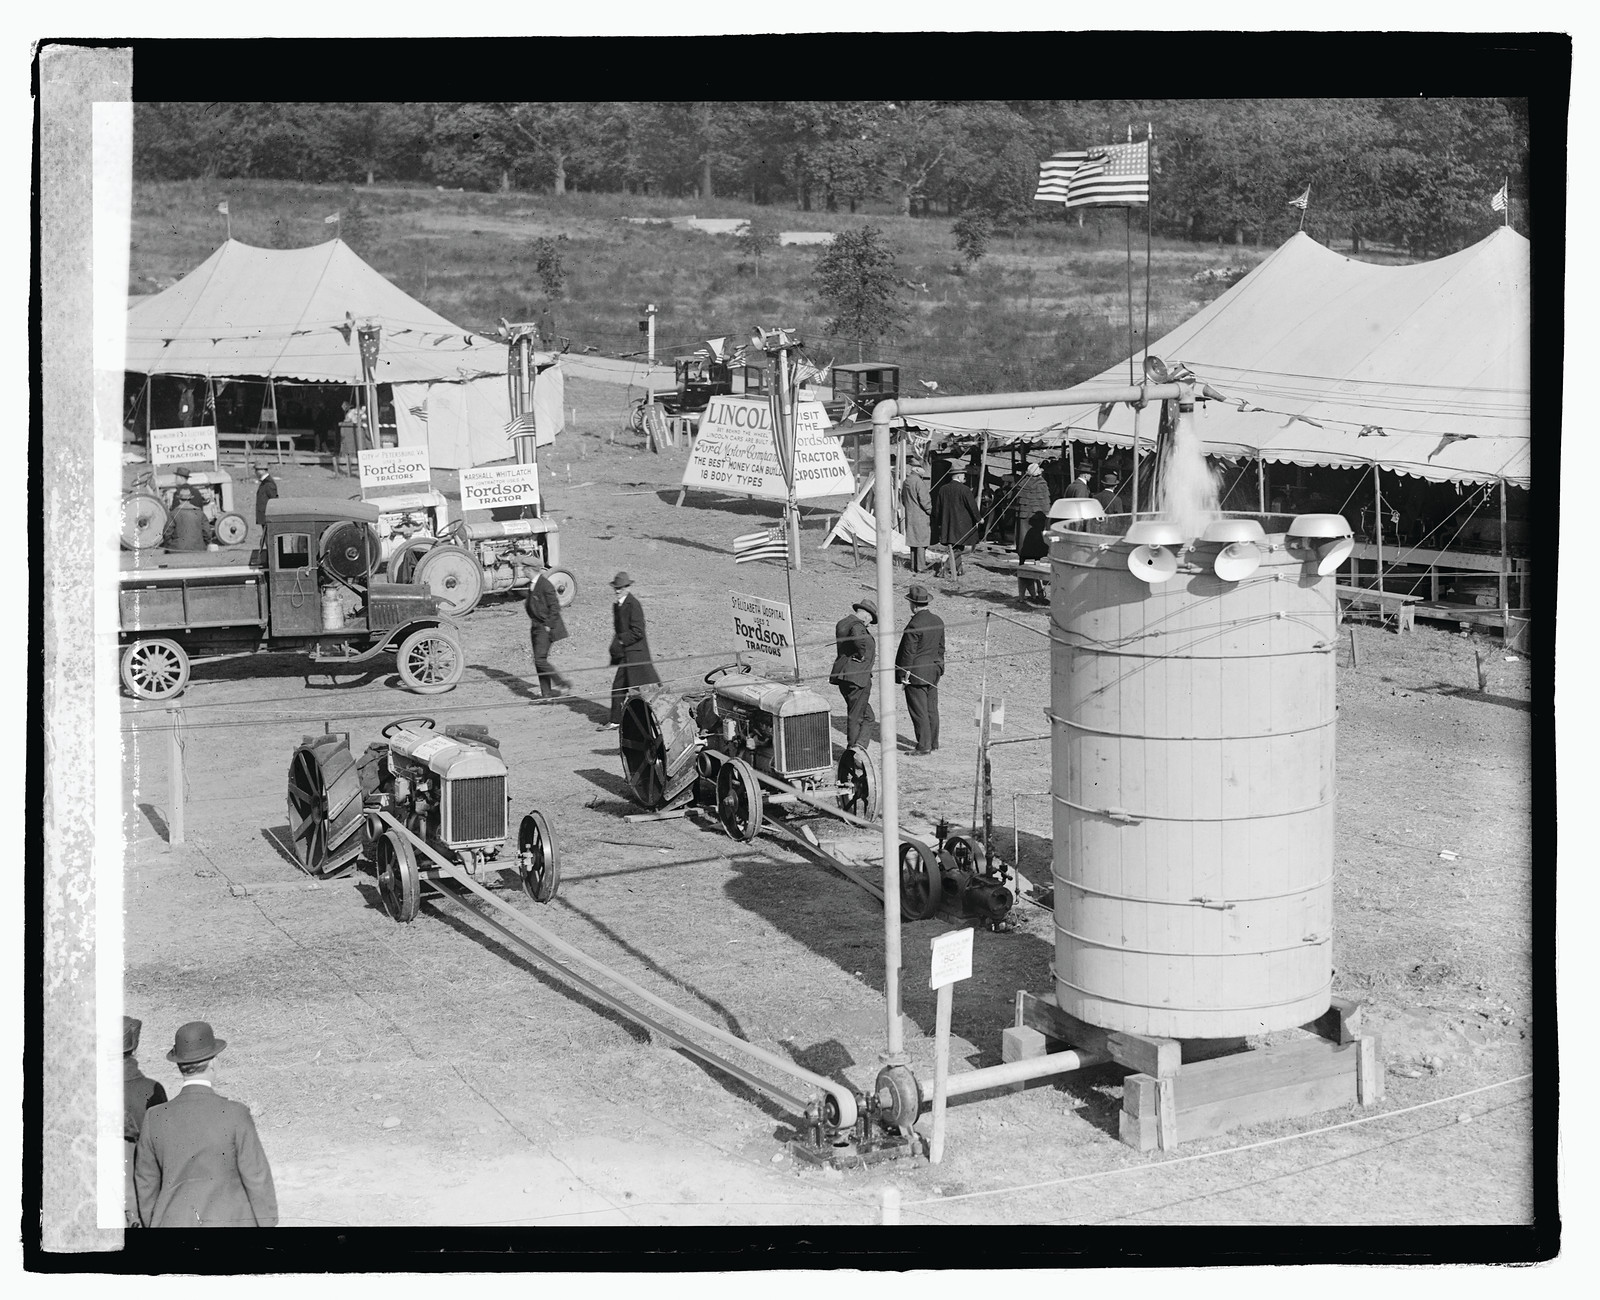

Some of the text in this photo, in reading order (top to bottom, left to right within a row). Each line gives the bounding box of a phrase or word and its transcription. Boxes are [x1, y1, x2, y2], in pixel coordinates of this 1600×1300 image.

[707, 402, 774, 430] LINCOL
[800, 411, 819, 420] ISIT
[798, 422, 819, 432] THE
[797, 434, 837, 446] ordson
[156, 442, 212, 454] Fordson
[695, 439, 722, 456] Ford
[795, 450, 840, 463] TRACTOR
[363, 463, 426, 476] Fordson
[694, 456, 706, 465] THE
[708, 458, 726, 469] BEST
[728, 462, 751, 472] MONEY
[752, 464, 764, 474] CAN
[376, 474, 414, 482] TRACTORS
[464, 469, 532, 481] MARSHALL WHITLATCH
[701, 469, 763, 487] 18 BODY TYPES
[465, 483, 534, 498] Fordson
[479, 495, 522, 504] TRACTOR
[734, 617, 789, 648] Fordson
[745, 640, 781, 657] TRACTORS
